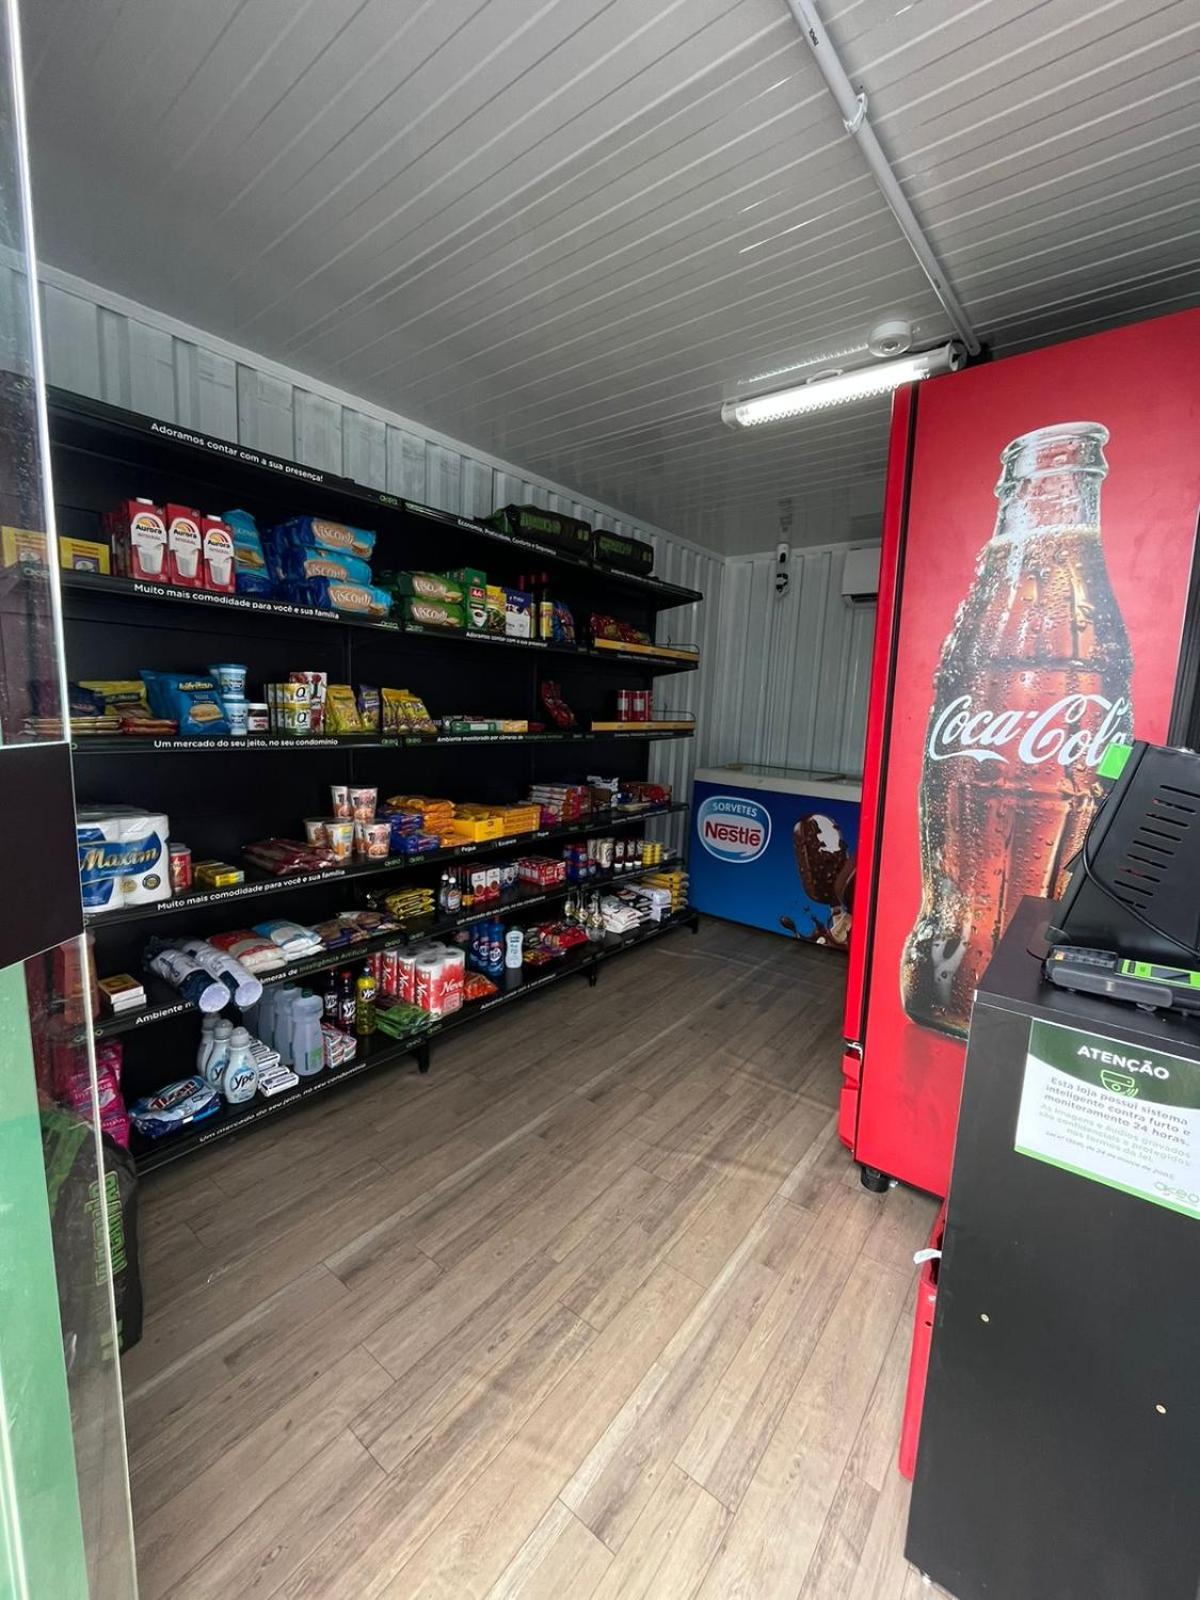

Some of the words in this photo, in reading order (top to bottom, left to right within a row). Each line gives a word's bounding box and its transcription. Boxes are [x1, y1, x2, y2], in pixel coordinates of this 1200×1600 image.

[151, 423, 205, 446] Adoramos
[207, 439, 238, 456] contar
[239, 450, 260, 463] com
[261, 458, 267, 466] a
[268, 459, 283, 470] sua
[285, 465, 323, 482] presença!
[135, 524, 162, 535] Aurora
[173, 528, 197, 539] Aurora
[207, 539, 230, 549] Aurora
[134, 583, 164, 596] Muito
[166, 589, 190, 600] mais
[192, 592, 250, 608] comodidade
[252, 601, 271, 612] para
[273, 603, 293, 613] você
[294, 606, 299, 614] e
[300, 607, 314, 616] sua
[314, 609, 339, 620] família
[154, 739, 171, 748] Um
[173, 739, 215, 748] mercado
[217, 739, 229, 748] do
[230, 740, 245, 748] seu
[246, 738, 267, 749] jeito,
[712, 802, 758, 818] SORVETES
[157, 899, 185, 911] Muito
[186, 894, 208, 905] mais
[209, 884, 263, 900] comodidade
[264, 881, 282, 892] para
[283, 877, 301, 887] você
[308, 873, 321, 882] sua
[321, 868, 345, 879] família
[288, 968, 298, 977] de
[135, 1004, 183, 1025] Ambiente
[1077, 1045, 1170, 1080] ATENÇÃO
[1046, 1084, 1105, 1109] inteligente
[1107, 1105, 1146, 1122] contra
[1149, 1117, 1179, 1133] furto
[1051, 1077, 1074, 1090] Esta
[1076, 1084, 1097, 1098] loja
[1100, 1092, 1138, 1110] possui
[1141, 1106, 1188, 1126] sistema
[1044, 1094, 1130, 1127] monitoramento
[1133, 1121, 1148, 1133] 24
[1151, 1127, 1190, 1146] horas.
